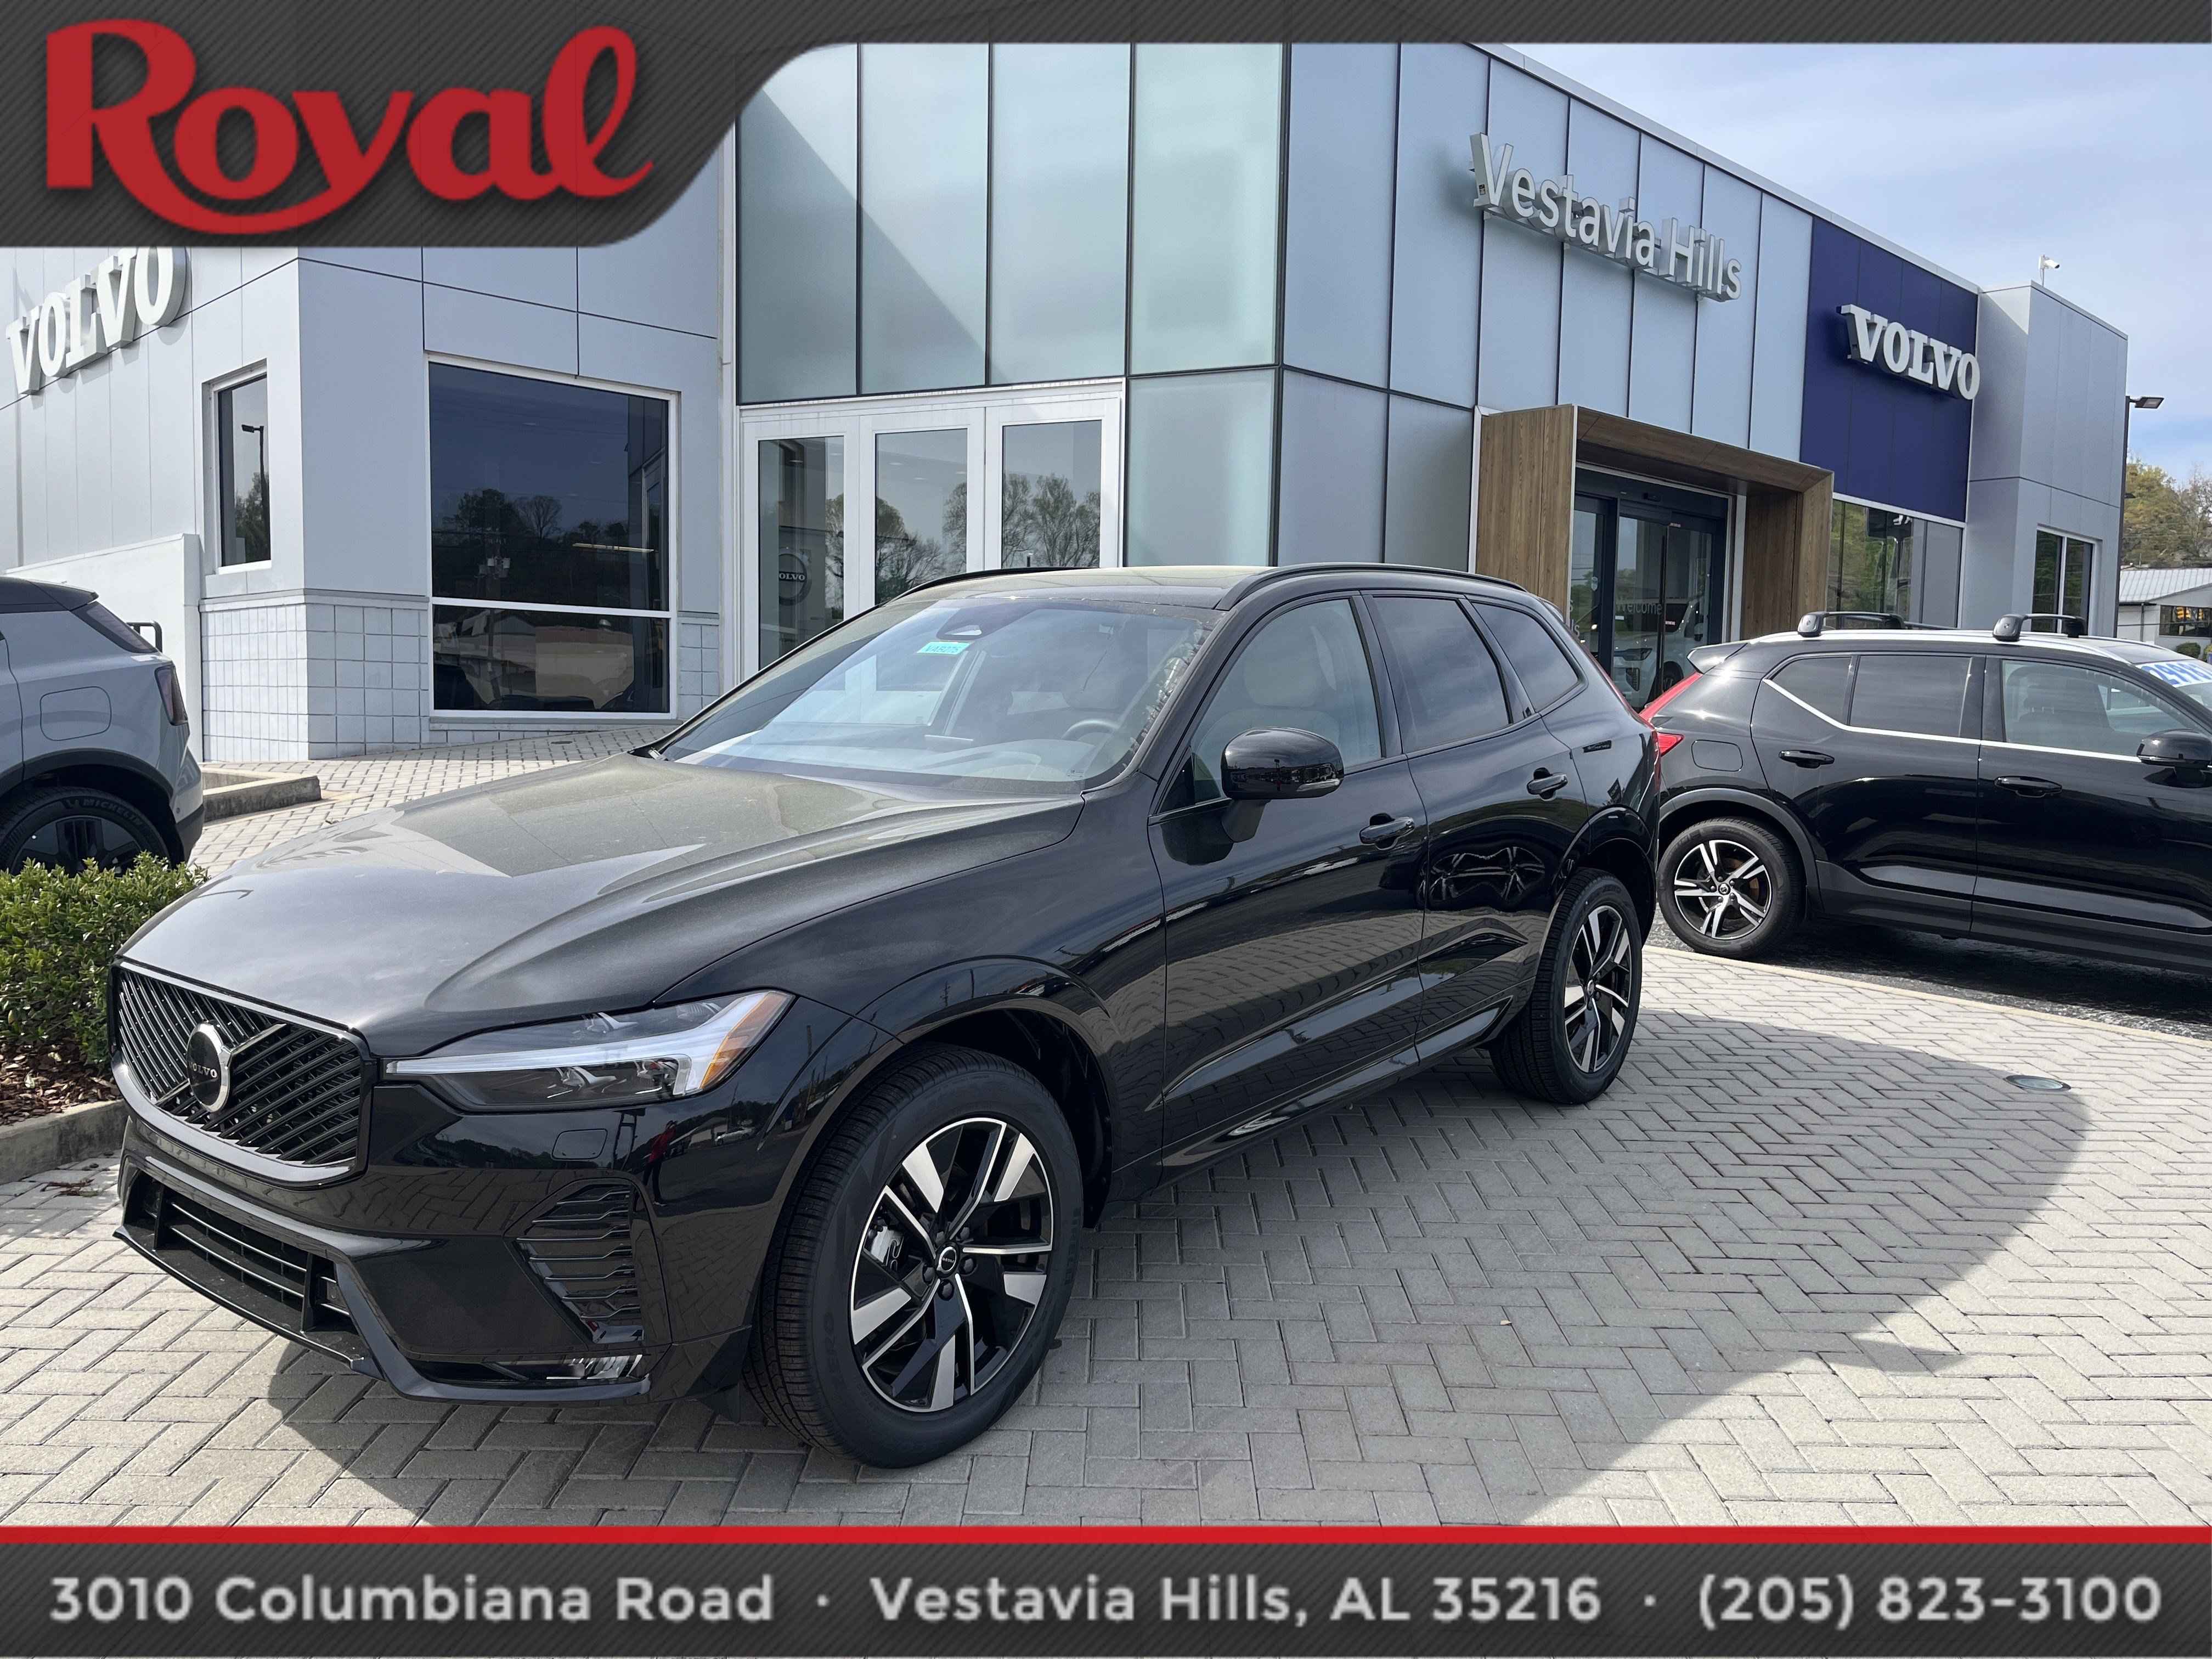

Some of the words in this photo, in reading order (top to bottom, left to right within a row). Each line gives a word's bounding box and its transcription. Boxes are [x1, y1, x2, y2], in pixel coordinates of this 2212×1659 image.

[1470, 132, 1656, 270] Vestavia
[1658, 217, 1741, 301] Hills
[5, 246, 187, 395] VOLVO
[1839, 303, 1980, 400] VOLVO
[778, 572, 805, 581] OLVO
[1616, 602, 1662, 616] Welcome
